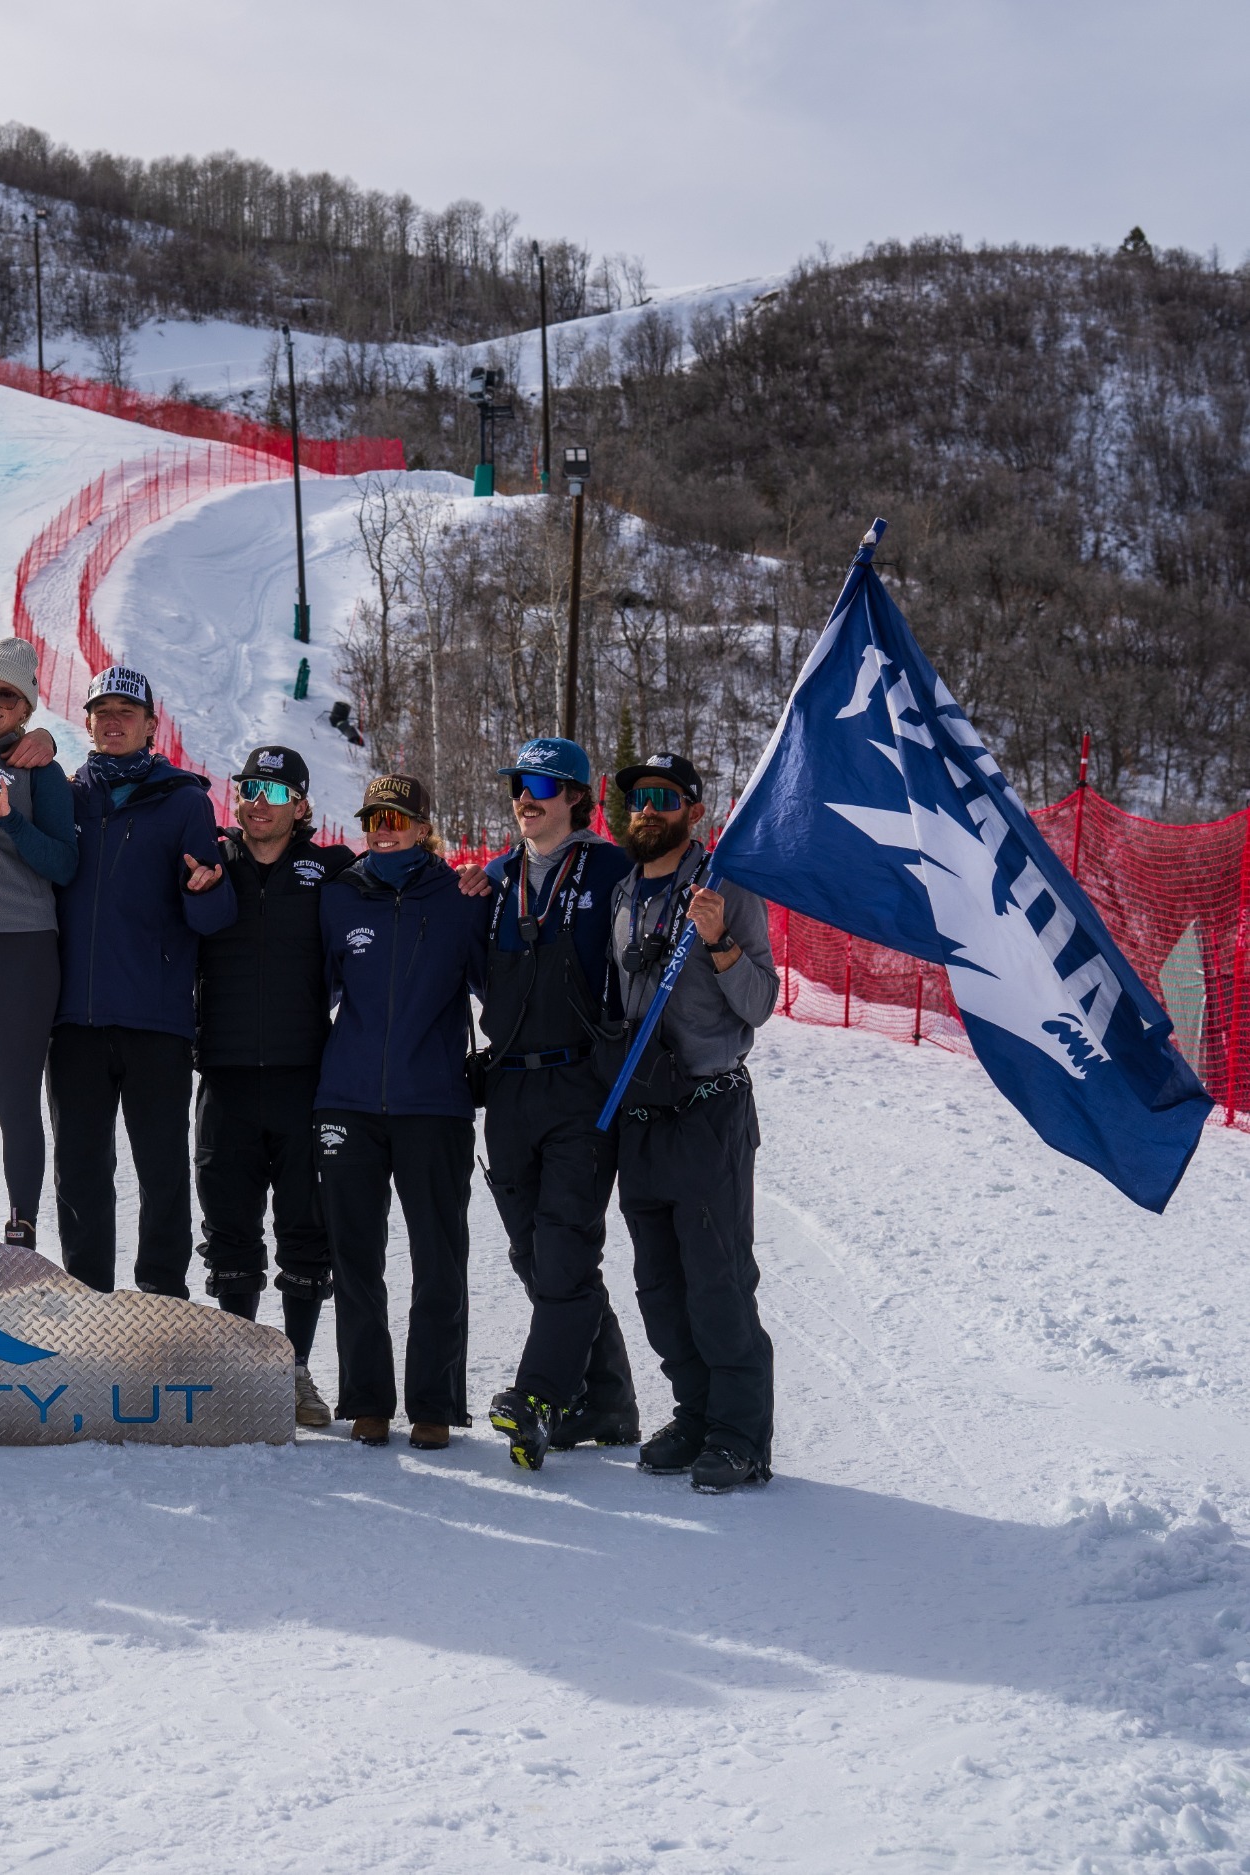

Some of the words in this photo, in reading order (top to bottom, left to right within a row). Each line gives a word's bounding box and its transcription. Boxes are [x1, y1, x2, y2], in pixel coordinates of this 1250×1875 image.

[119, 667, 145, 688] HORSE
[115, 680, 140, 697] SKIER
[369, 781, 411, 798] SKIING
[293, 860, 326, 873] NEVADA
[346, 927, 375, 941] NEVADA
[112, 1384, 213, 1424] UT
